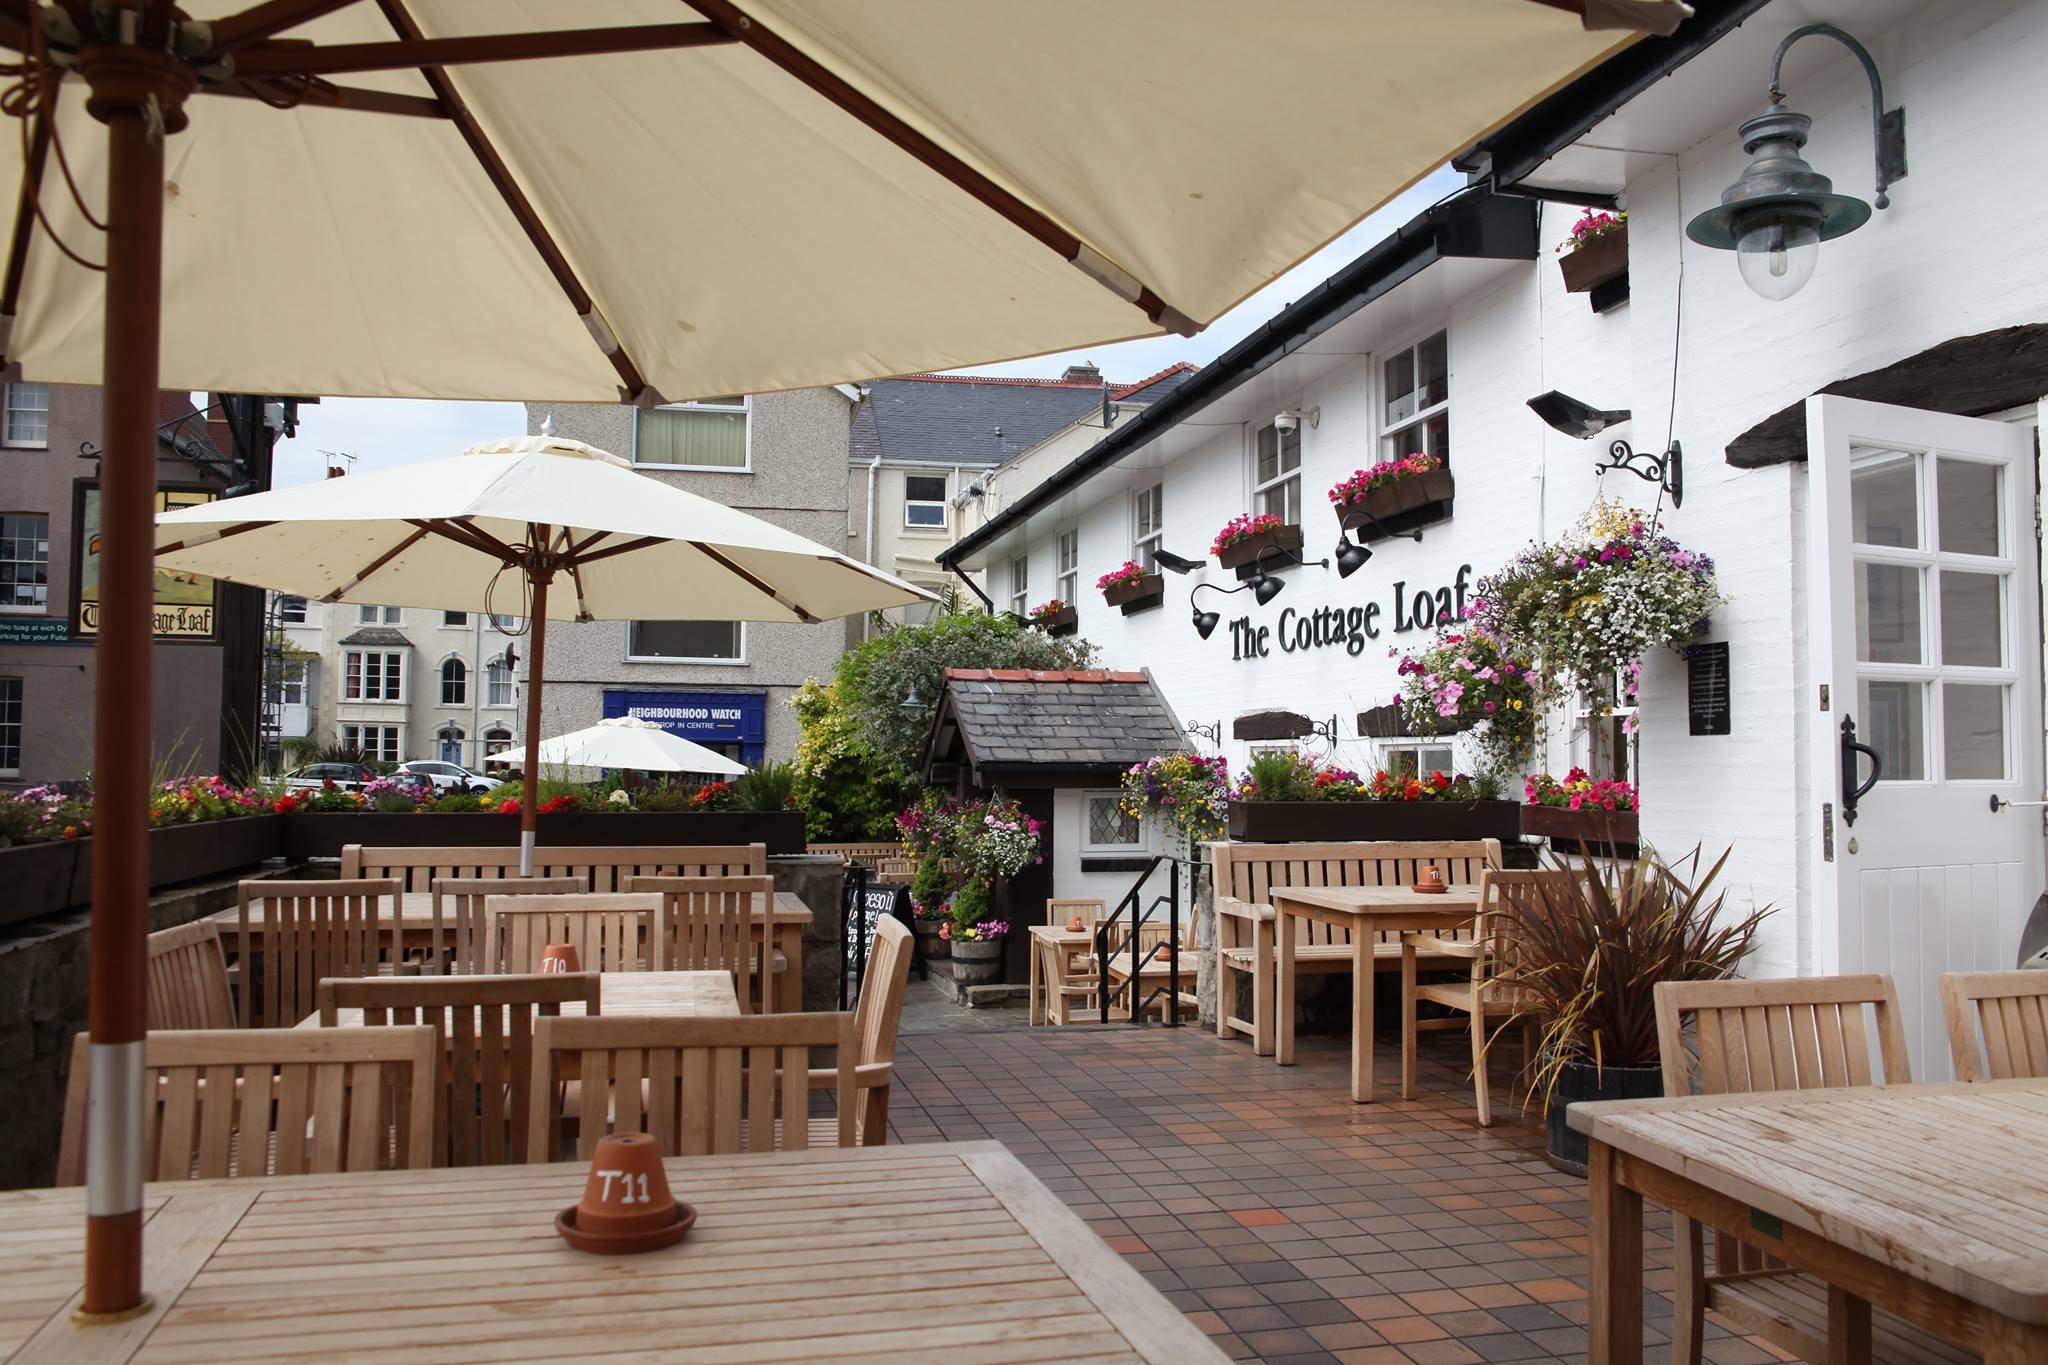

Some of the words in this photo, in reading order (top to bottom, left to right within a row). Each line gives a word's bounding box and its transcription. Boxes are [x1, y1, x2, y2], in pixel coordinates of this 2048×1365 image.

[176, 606, 211, 633] Loaf
[1229, 615, 1269, 661] The
[1278, 602, 1381, 657] Cottage
[1393, 563, 1472, 633] Loaf
[629, 707, 708, 719] NEIGHBOURHOOD
[711, 708, 741, 720] WATCH
[596, 1170, 651, 1204] T11
